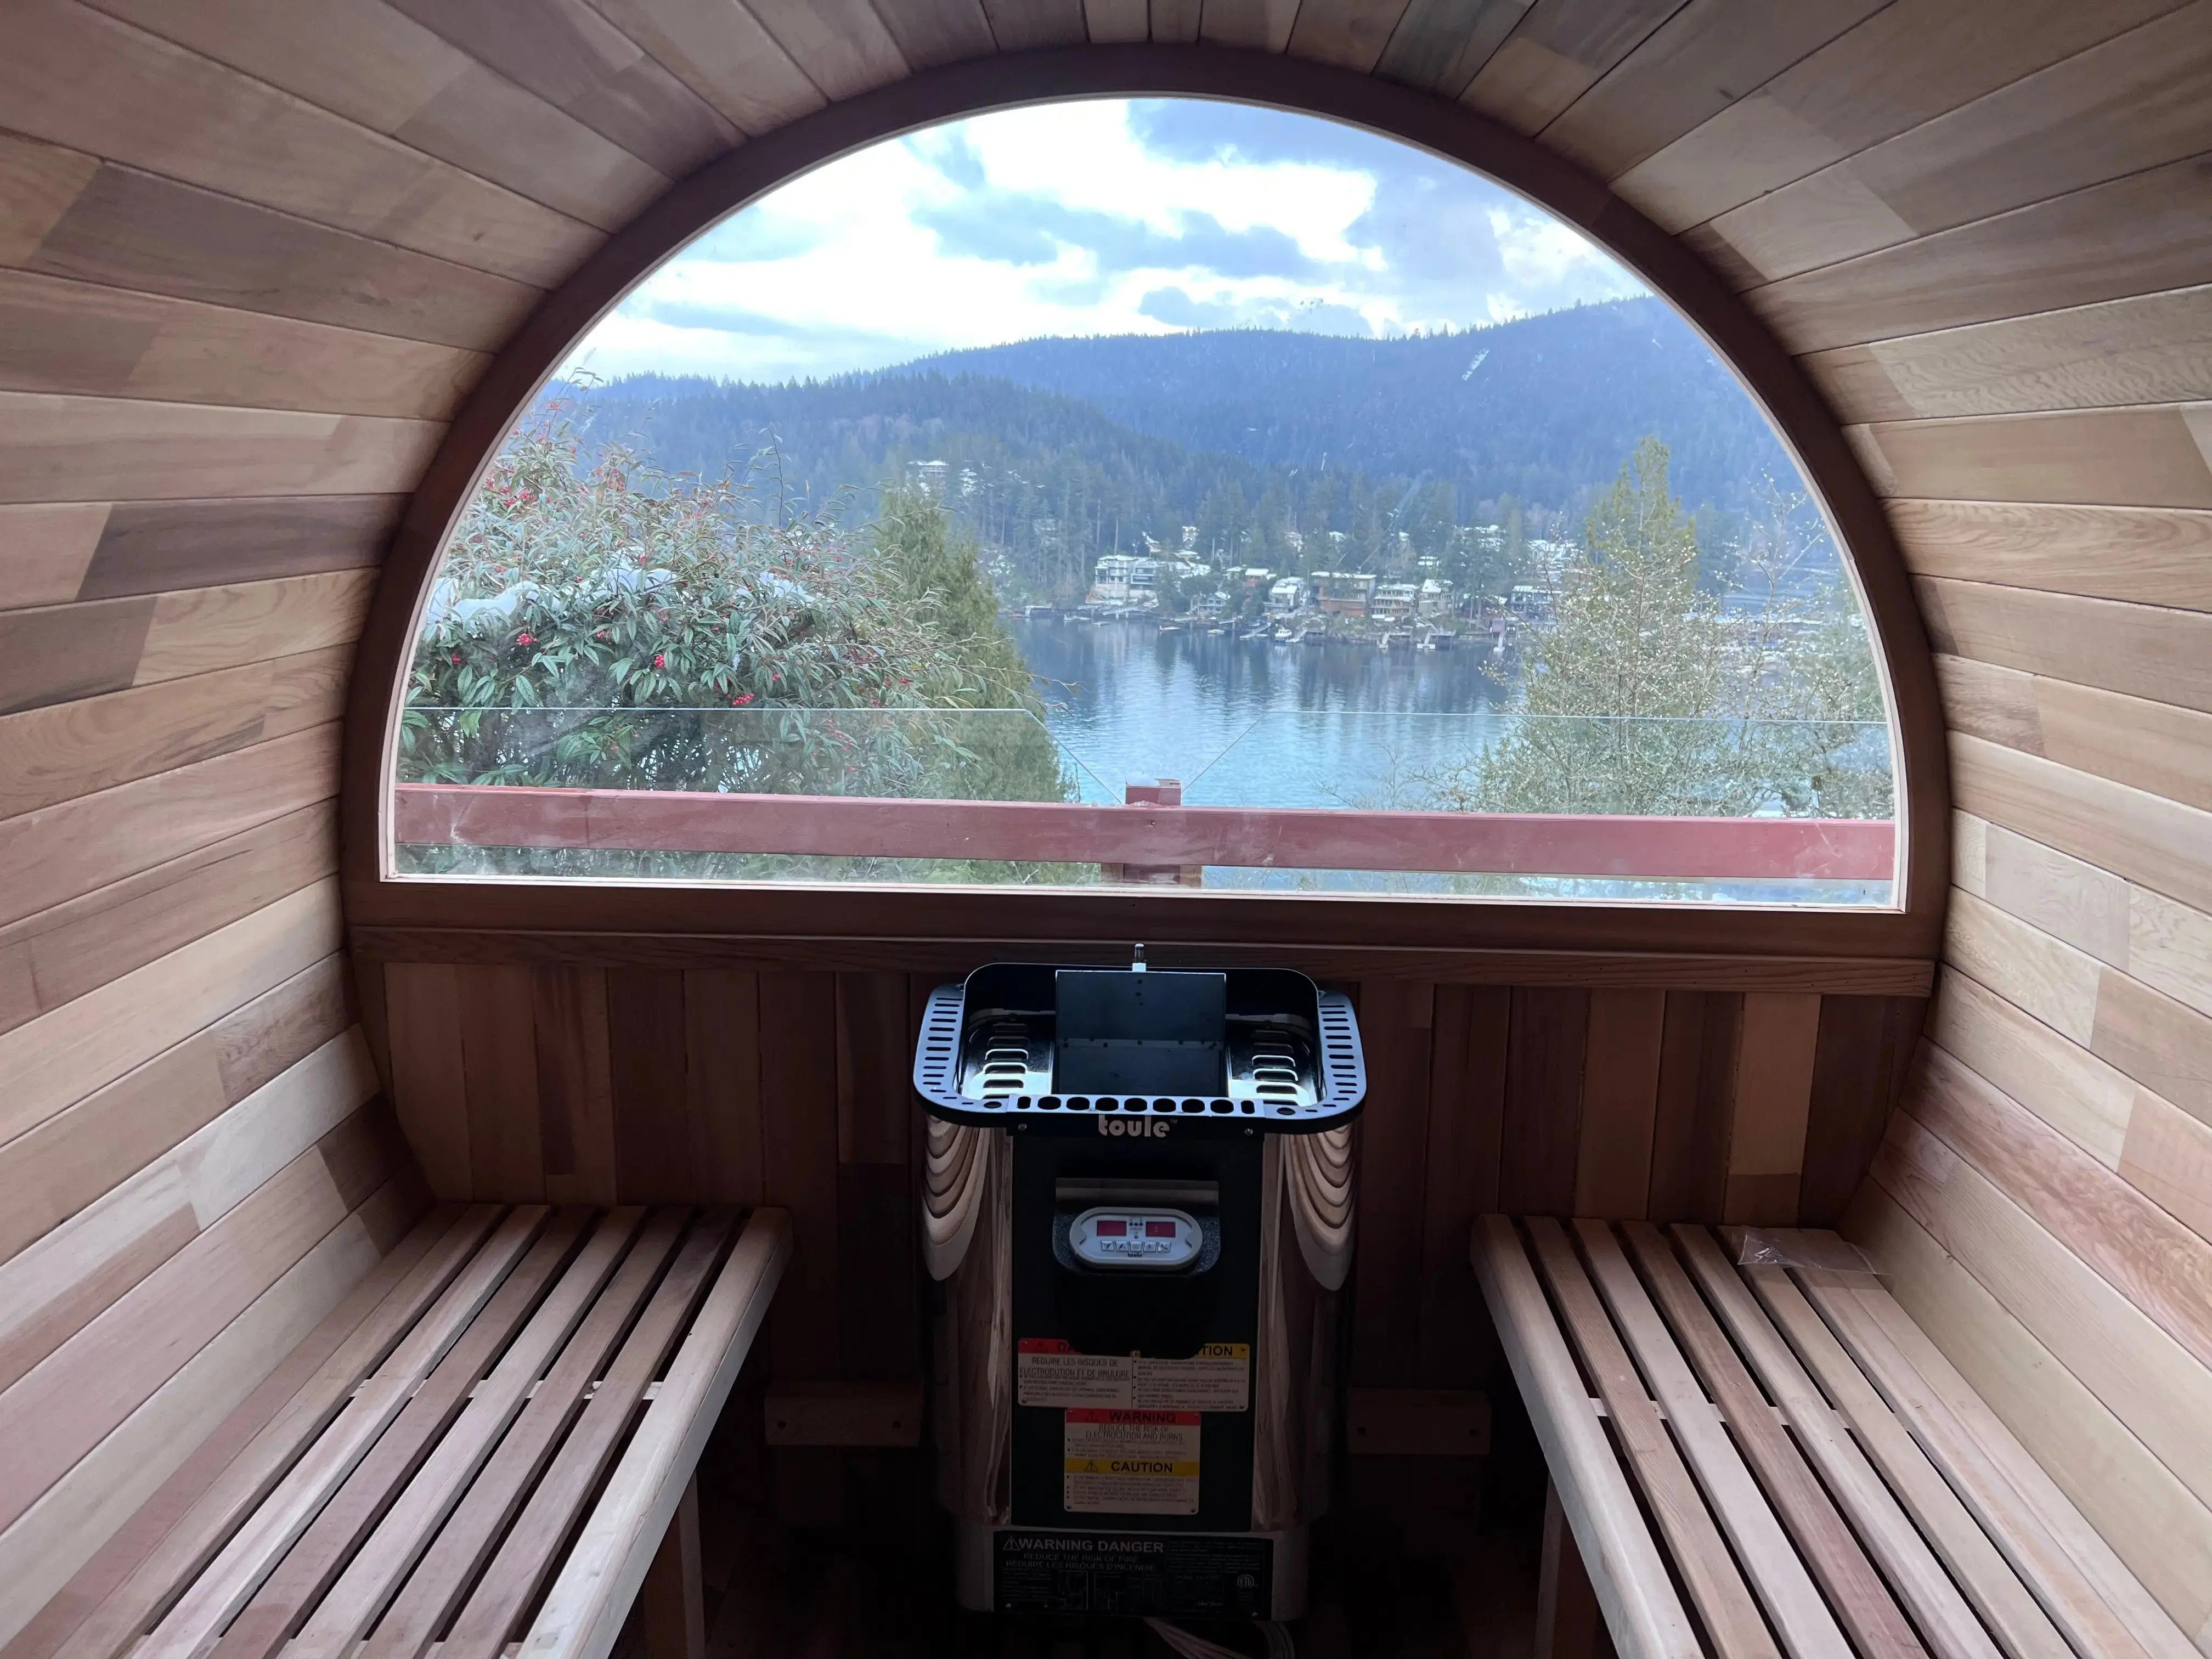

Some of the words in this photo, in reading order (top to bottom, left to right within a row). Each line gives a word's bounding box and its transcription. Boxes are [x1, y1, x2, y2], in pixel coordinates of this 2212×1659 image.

[1099, 1114, 1170, 1138] toule
[1197, 1346, 1233, 1356] TION
[1078, 1358, 1107, 1367] RISQUES
[1109, 1411, 1176, 1423] WARNING
[1086, 1431, 1141, 1440] ELECTROCUTION
[1143, 1432, 1157, 1440] AND
[1159, 1433, 1183, 1441] BURNS
[1110, 1462, 1173, 1472] CAUTION
[1018, 1538, 1093, 1551] WARNING
[1098, 1541, 1164, 1553] DANGER
[1065, 1561, 1104, 1570] RISQUES
